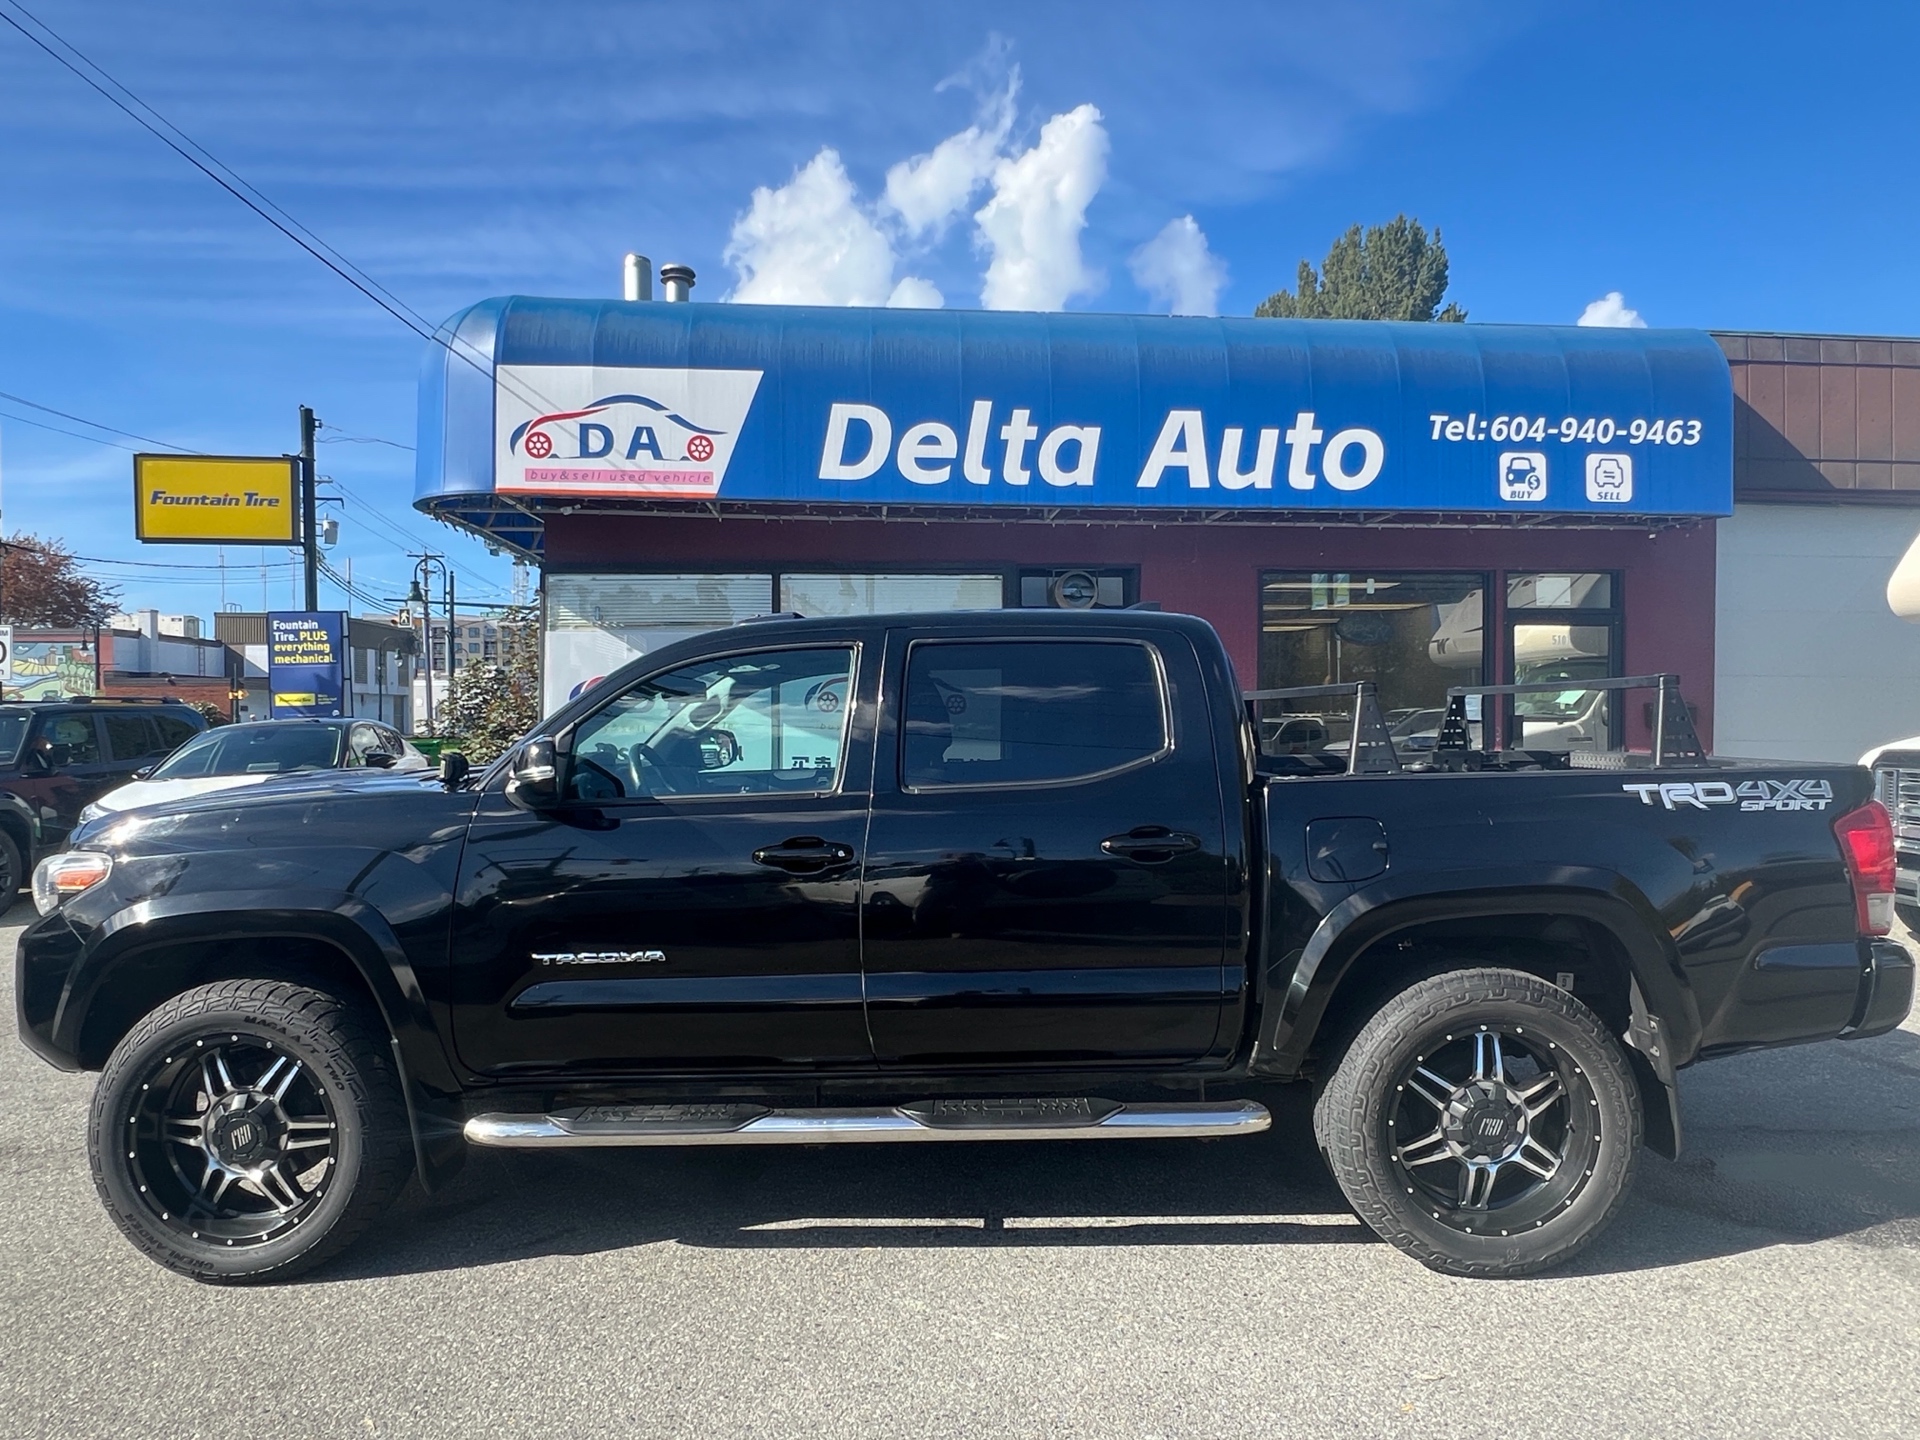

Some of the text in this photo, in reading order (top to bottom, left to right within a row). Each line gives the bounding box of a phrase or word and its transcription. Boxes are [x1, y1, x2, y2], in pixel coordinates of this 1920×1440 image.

[818, 400, 1384, 491] Delta Auto
[530, 470, 711, 483] buy&sell used vehicle
[150, 491, 280, 507] Fountain Tire
[1510, 490, 1533, 499] BUY
[1597, 491, 1621, 500] SELL
[273, 620, 318, 630] Fountain
[273, 631, 328, 641] Tire. PLUS
[274, 642, 330, 653] everything
[274, 653, 337, 664] mechanical.
[1622, 782, 1738, 811] TRD
[1740, 798, 1832, 811] SPORT
[531, 950, 666, 966] TACOMA
